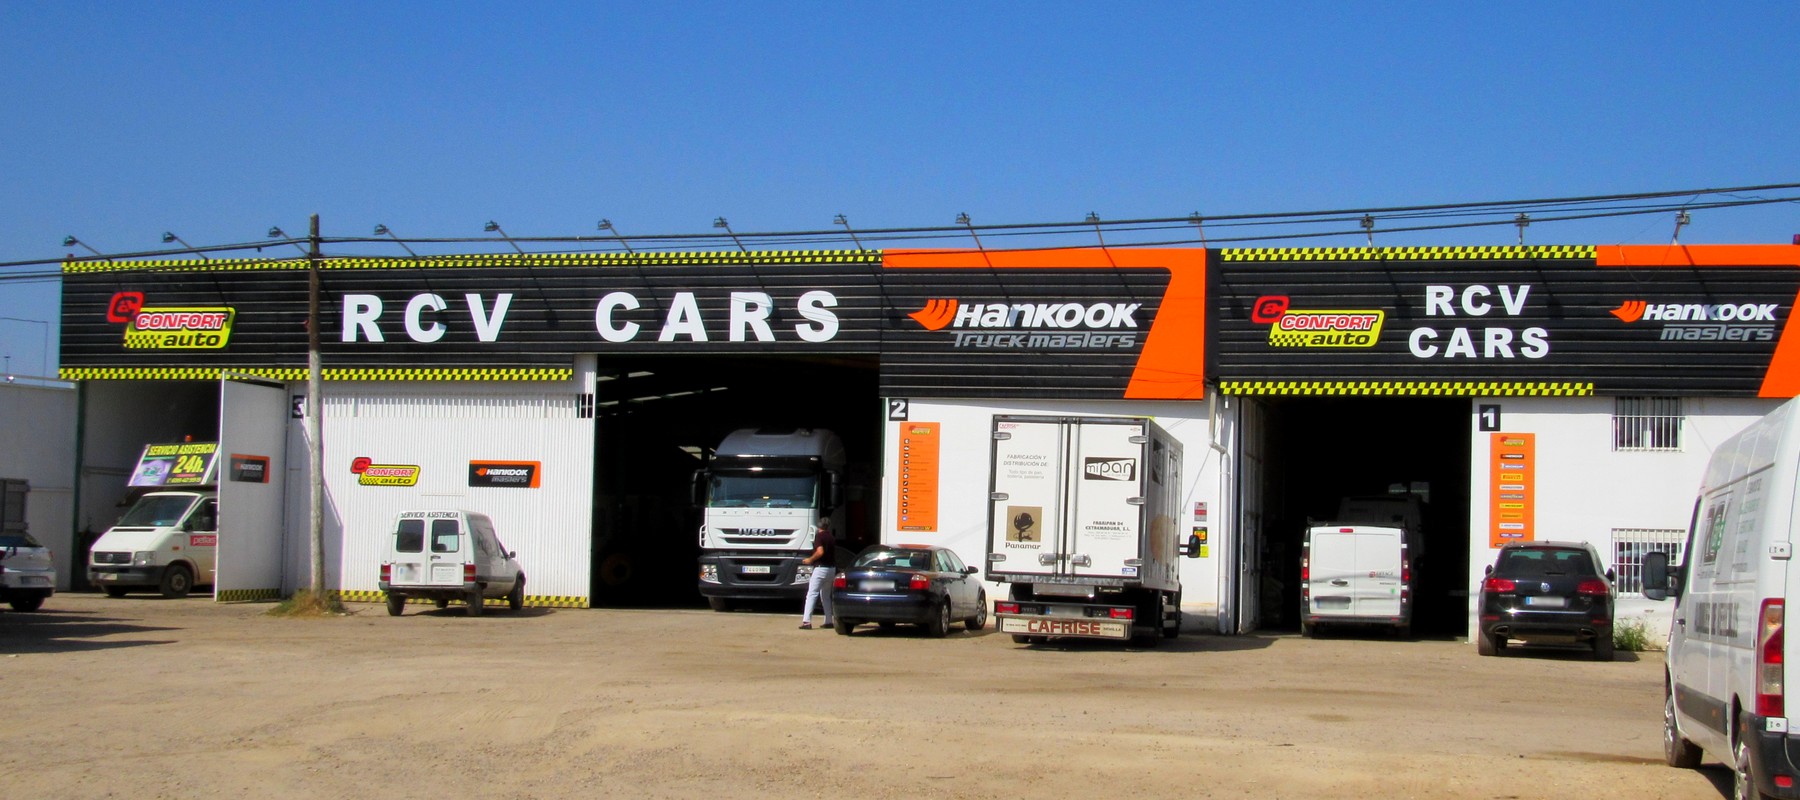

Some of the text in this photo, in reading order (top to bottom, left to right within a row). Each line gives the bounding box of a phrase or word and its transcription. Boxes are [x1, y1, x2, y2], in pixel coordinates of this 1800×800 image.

[1426, 284, 1531, 316] RCV
[136, 313, 227, 330] CONFORT
[342, 291, 840, 343] RCV CARS
[1280, 314, 1378, 330] CONFORT
[163, 332, 221, 347] auto
[1310, 331, 1371, 346] auto
[1408, 326, 1550, 358] CARS
[890, 400, 906, 418] 2
[1482, 407, 1496, 428] 1
[148, 443, 217, 456] SERVICIO ASISTENCIA
[366, 468, 416, 477] CONFORT
[738, 527, 775, 536] IVECO
[1005, 542, 1042, 550] Panamar
[1027, 619, 1101, 635] CAFRISE
